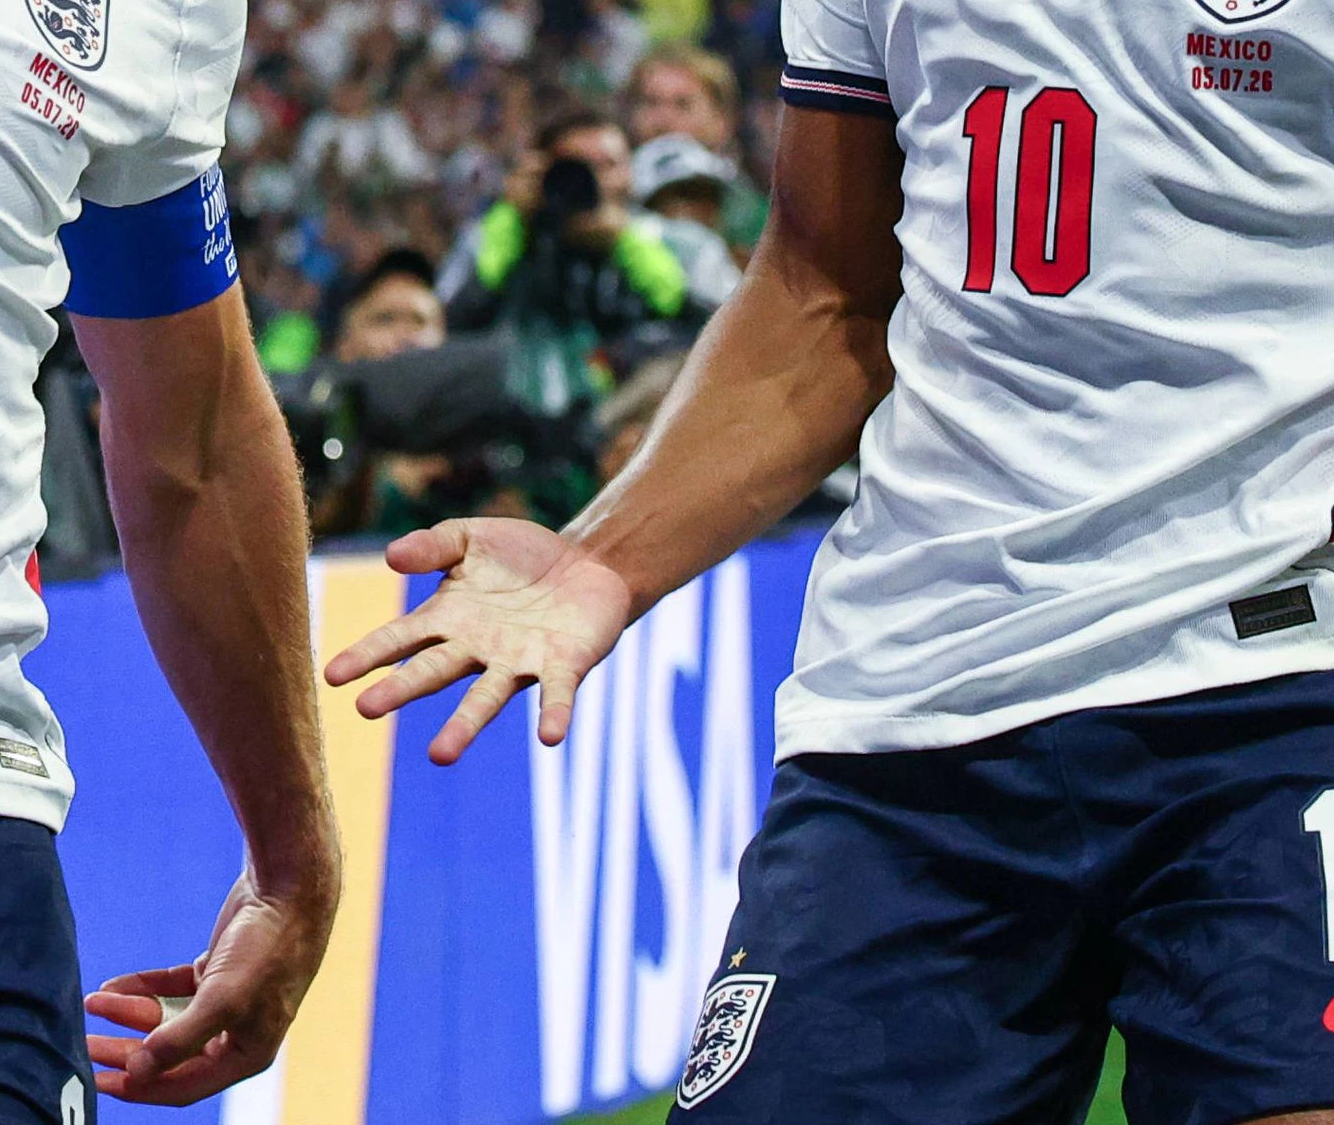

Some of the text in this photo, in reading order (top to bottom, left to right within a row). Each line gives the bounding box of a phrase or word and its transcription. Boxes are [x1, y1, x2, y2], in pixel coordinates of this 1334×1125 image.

[1187, 32, 1272, 62] MEXICO
[29, 51, 86, 113] MEXICO
[1191, 66, 1273, 93] 05.07.26
[961, 85, 1098, 298] 10
[527, 551, 759, 1117] VISA
